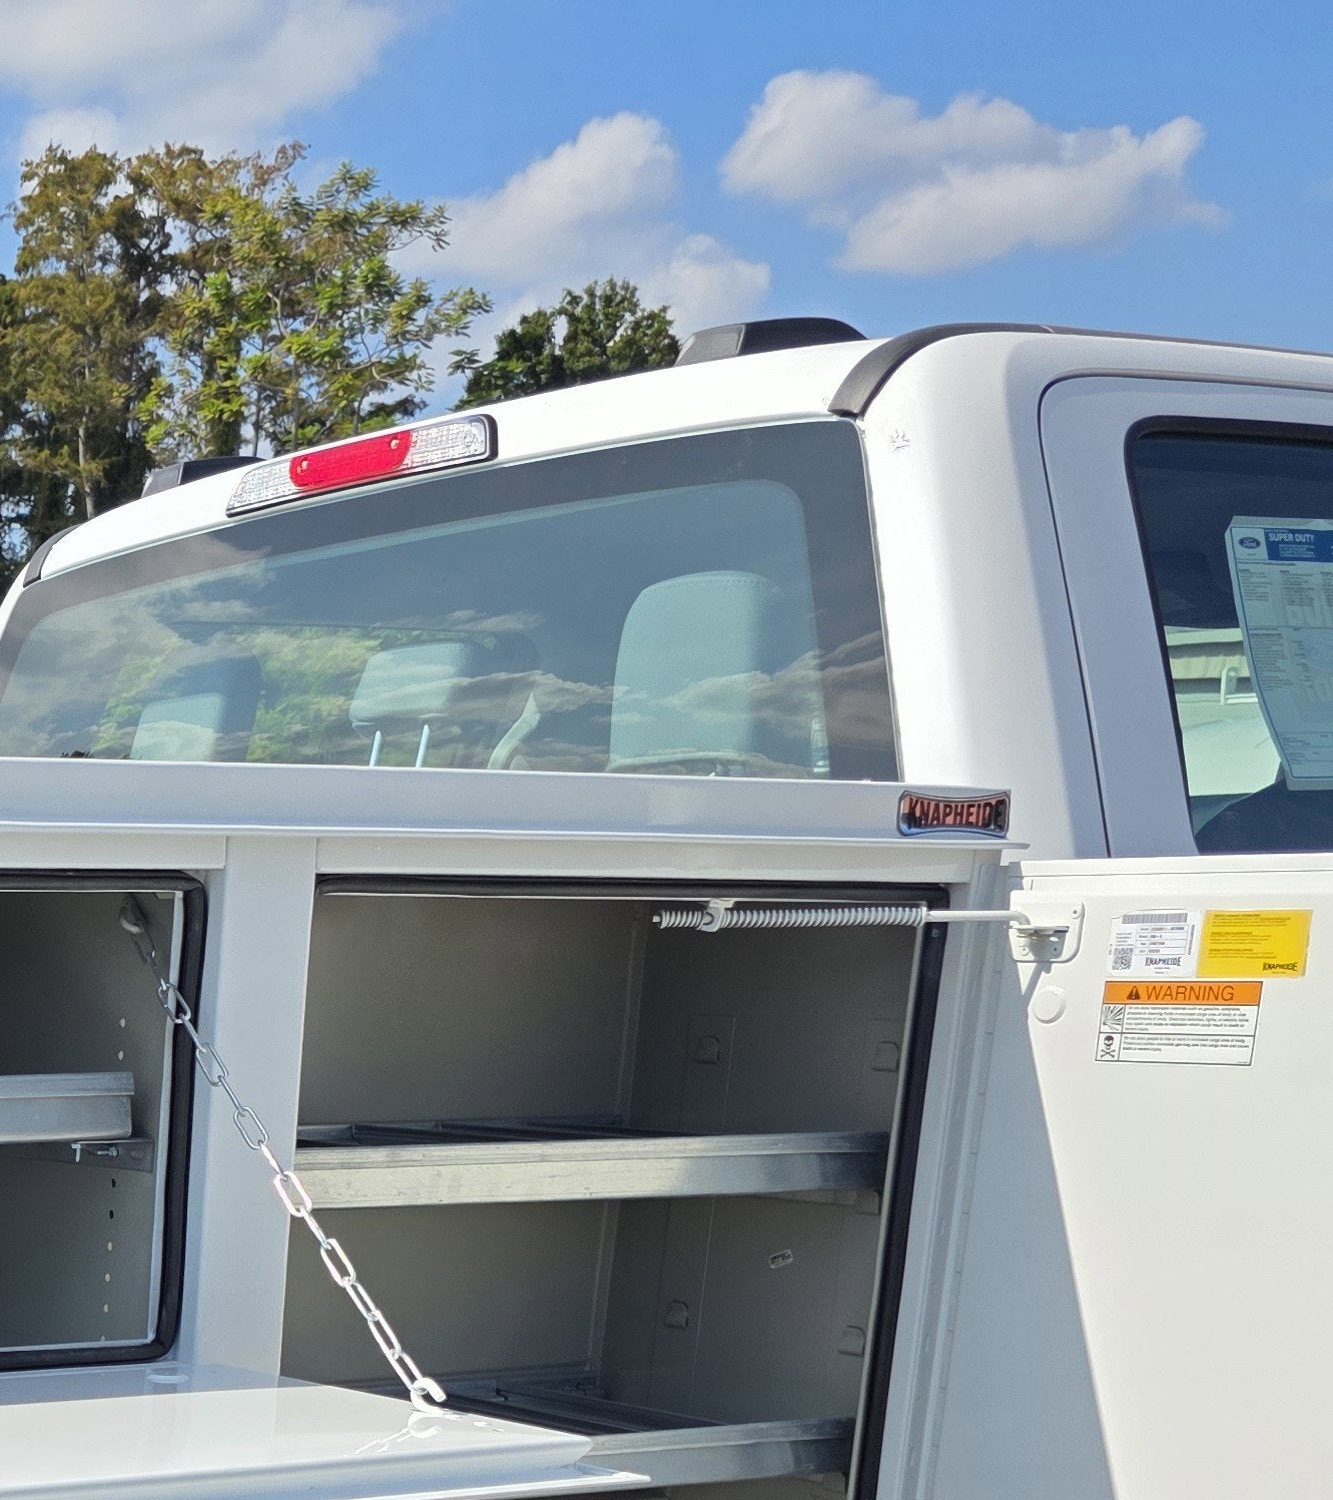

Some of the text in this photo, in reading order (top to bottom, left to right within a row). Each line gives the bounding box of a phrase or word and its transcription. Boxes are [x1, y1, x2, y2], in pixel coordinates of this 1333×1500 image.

[1268, 532, 1315, 543] SUPER DUTY
[907, 797, 1006, 831] KNAPHEIDE
[1146, 985, 1235, 1002] WARNING
